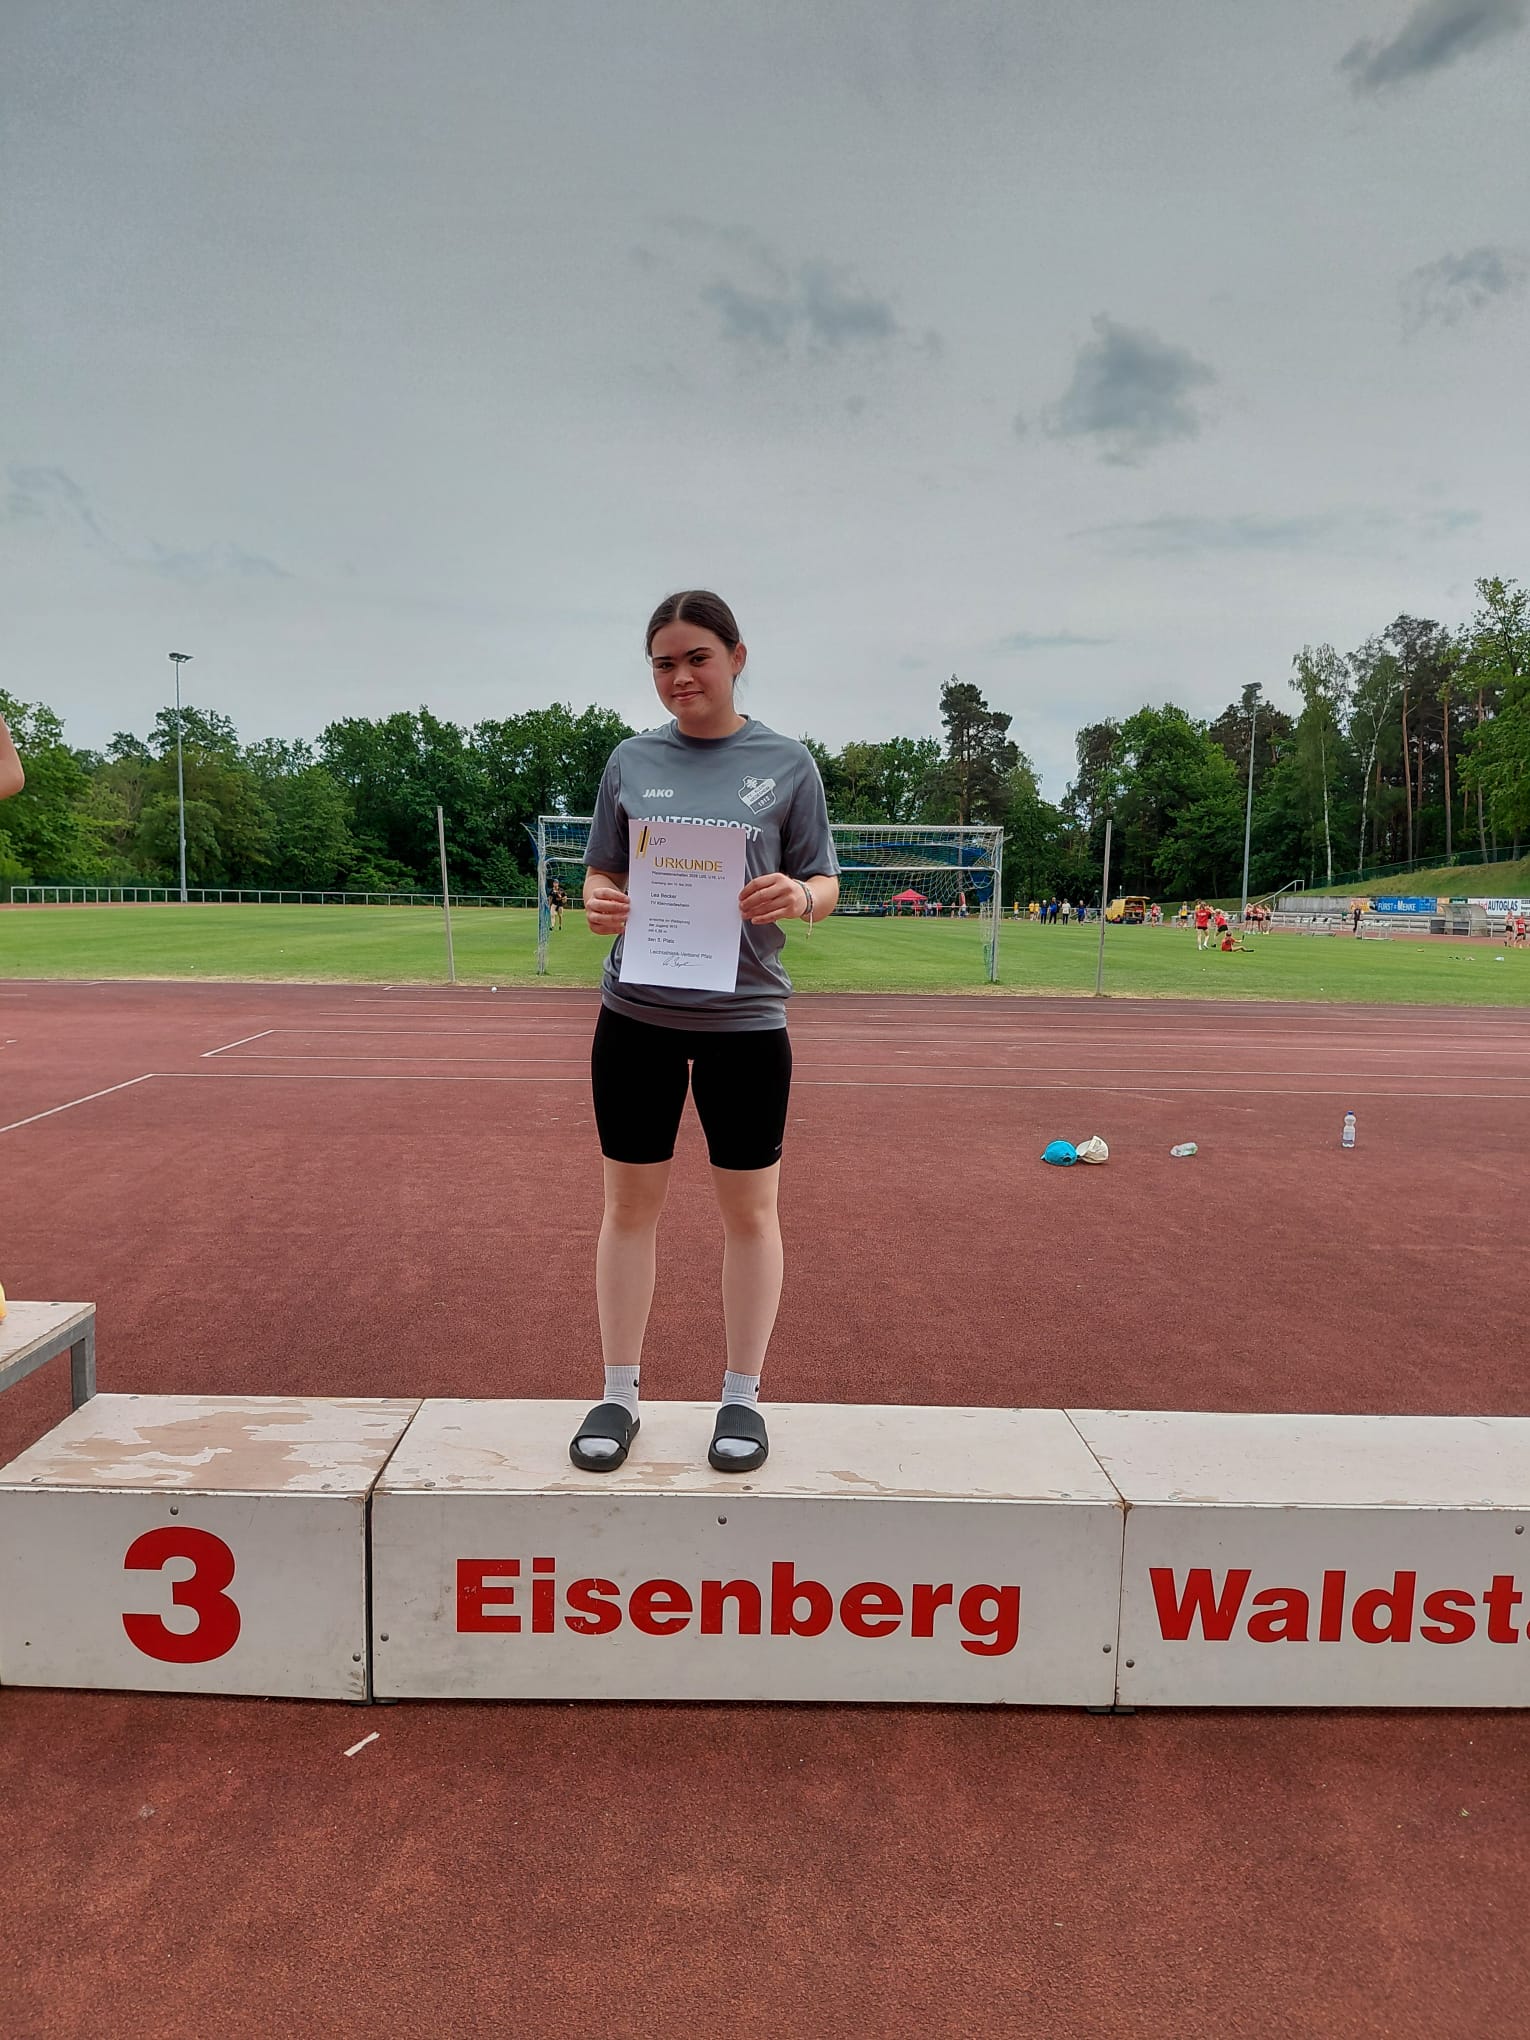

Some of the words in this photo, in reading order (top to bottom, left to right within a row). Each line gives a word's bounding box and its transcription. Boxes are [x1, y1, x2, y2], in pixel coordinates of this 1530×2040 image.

[642, 788, 674, 798] JAKO
[649, 836, 667, 846] LVP
[654, 856, 724, 873] URKUNDE
[1487, 900, 1519, 912] AUTOGLAS
[123, 1527, 241, 1662] 3
[456, 1558, 1020, 1656] Eisenberg
[1150, 1568, 1530, 1643] Waldst
